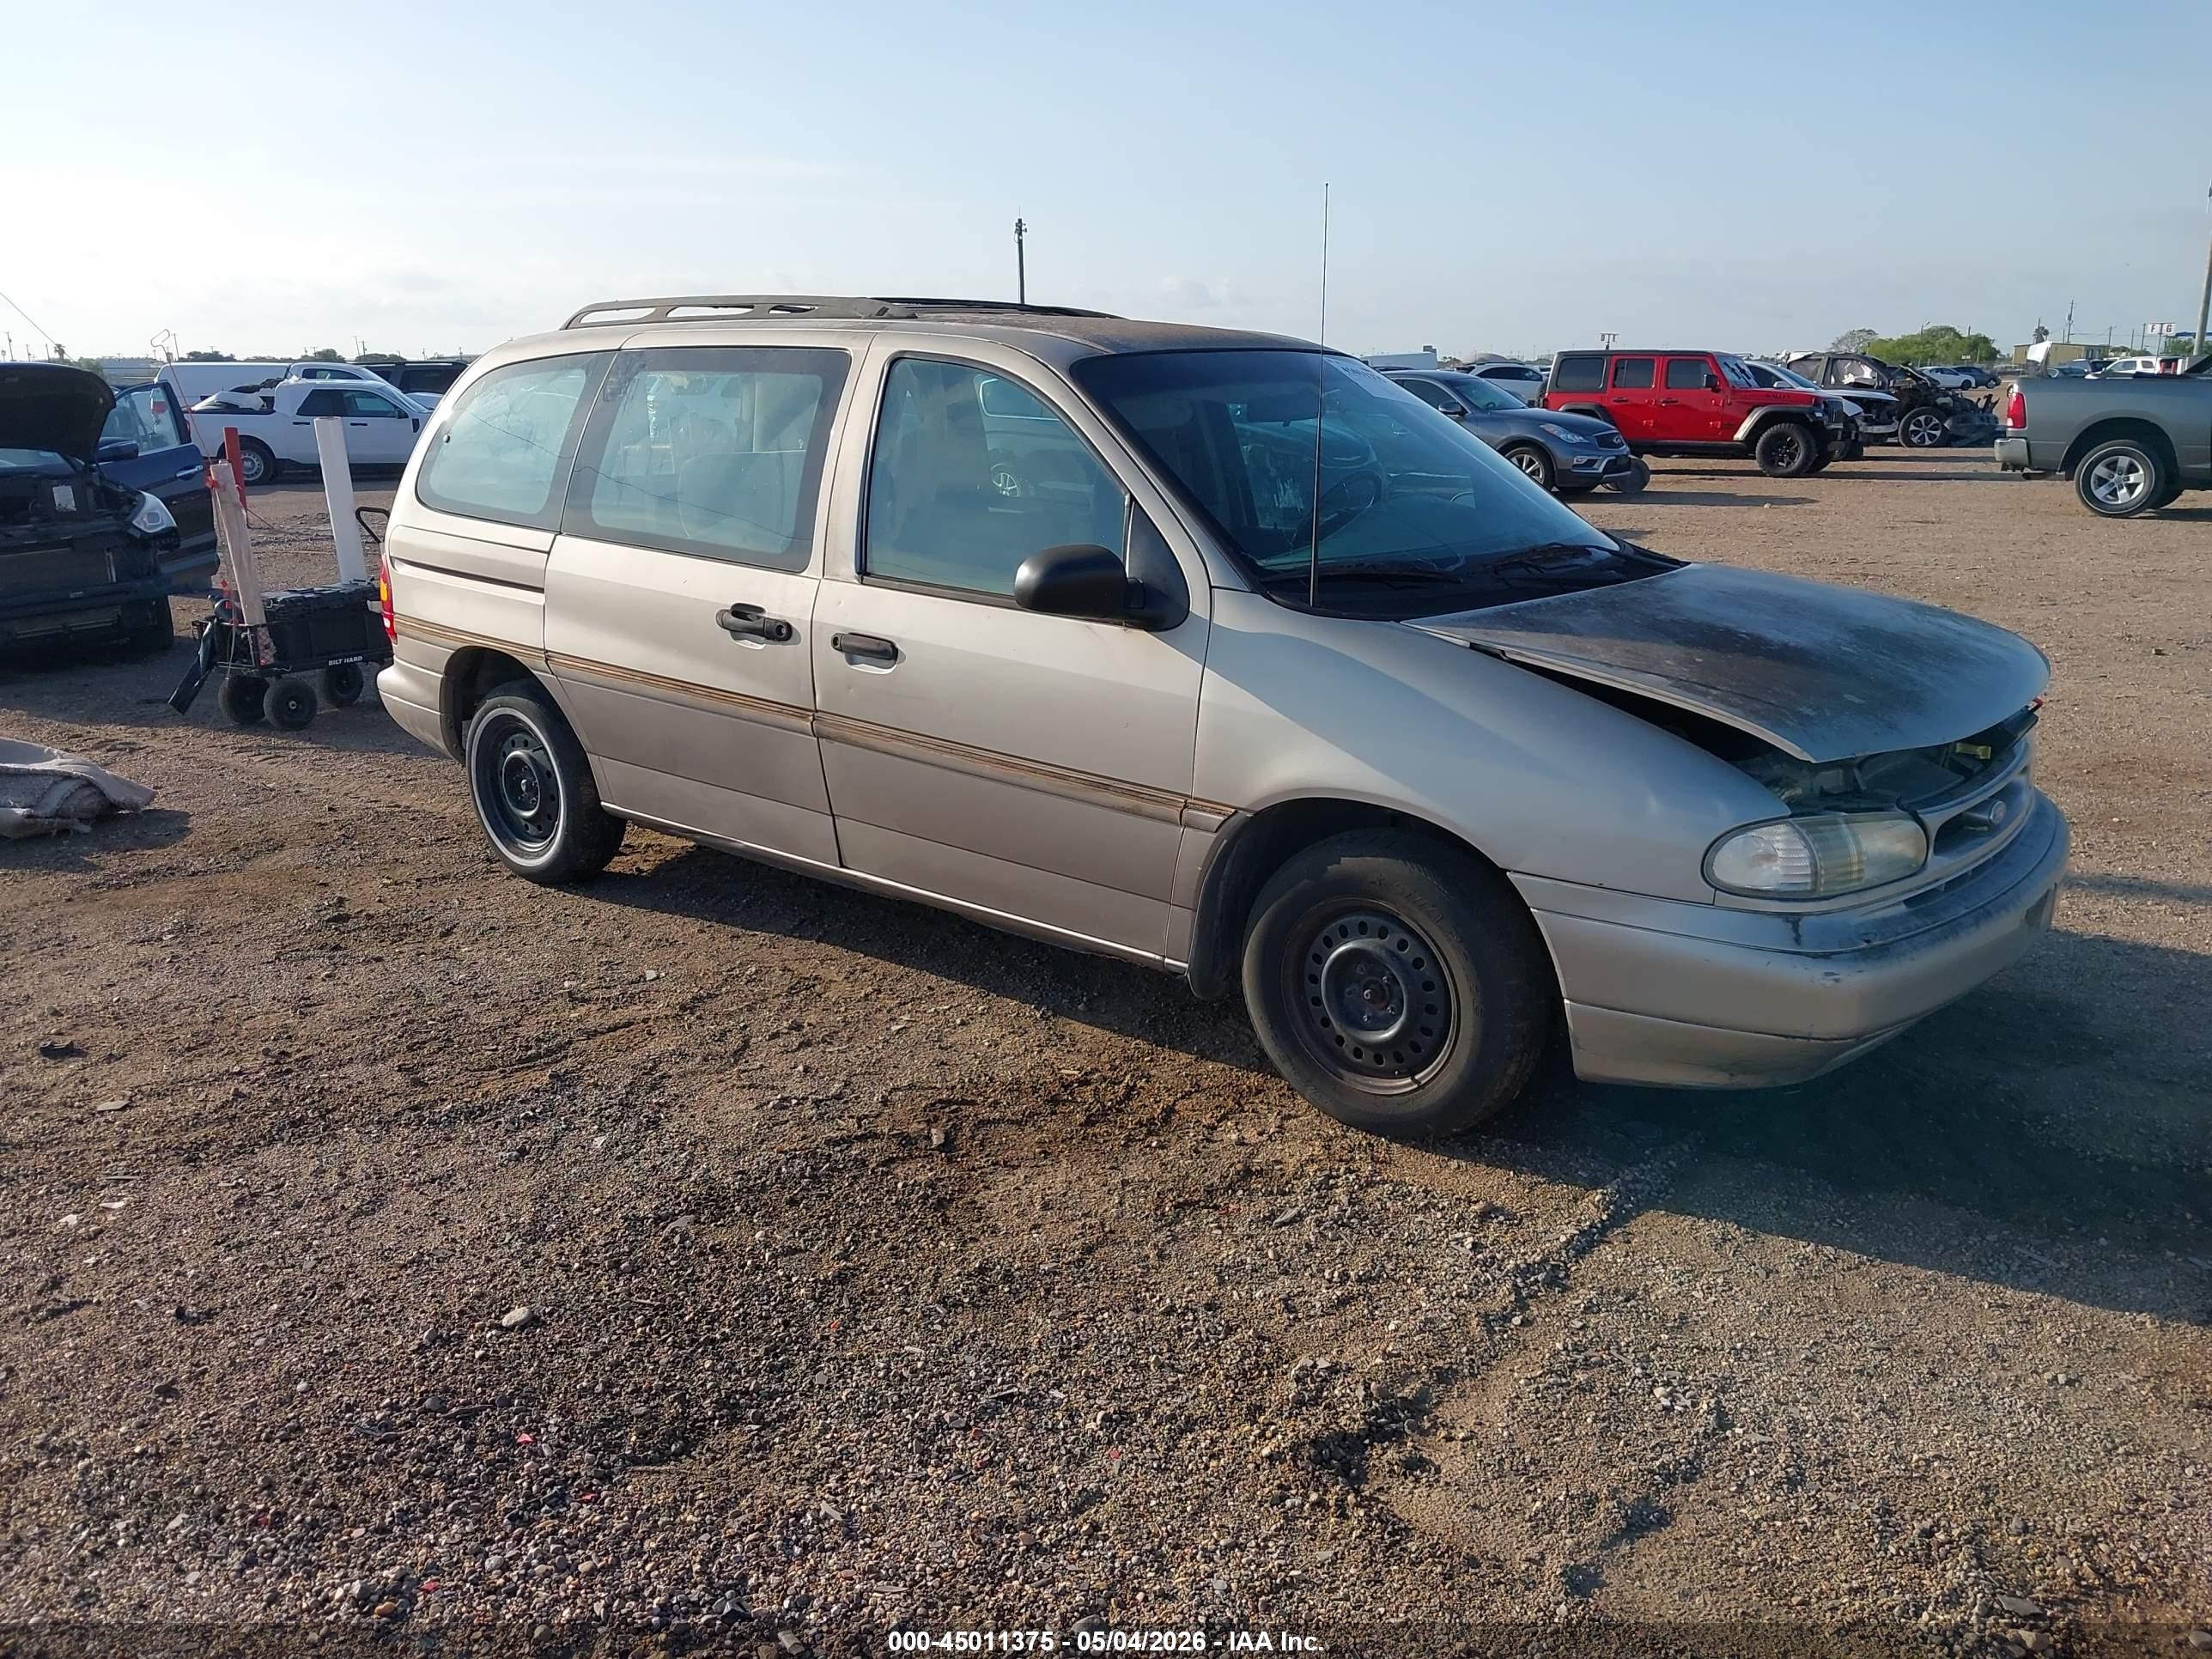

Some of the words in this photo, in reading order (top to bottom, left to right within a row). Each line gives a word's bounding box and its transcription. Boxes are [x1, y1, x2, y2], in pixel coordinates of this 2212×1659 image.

[2150, 324, 2156, 333] F
[2166, 324, 2172, 333] G
[343, 655, 363, 664] HARD
